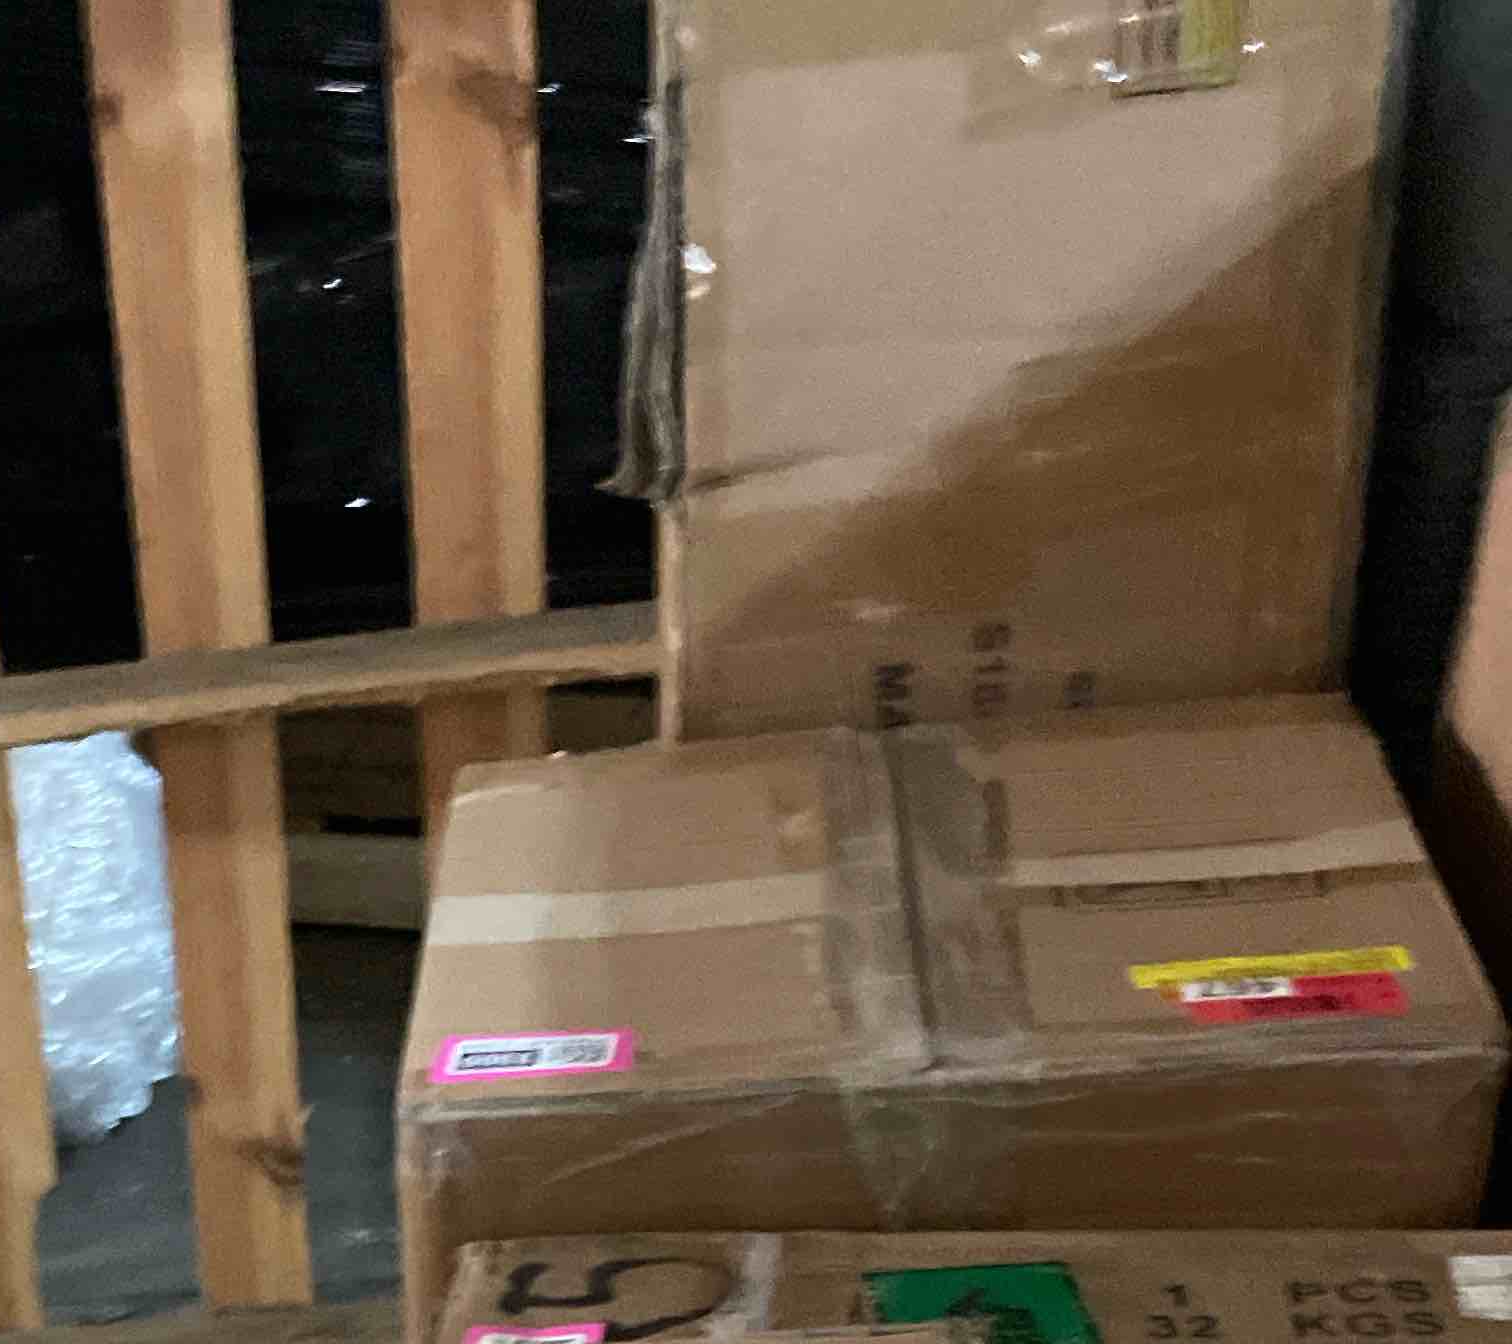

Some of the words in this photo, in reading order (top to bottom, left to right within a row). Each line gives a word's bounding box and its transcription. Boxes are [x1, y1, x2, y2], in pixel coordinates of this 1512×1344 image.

[1289, 1279, 1431, 1305] PCS
[1146, 1313, 1221, 1339] 32
[1290, 1312, 1445, 1338] KGS
